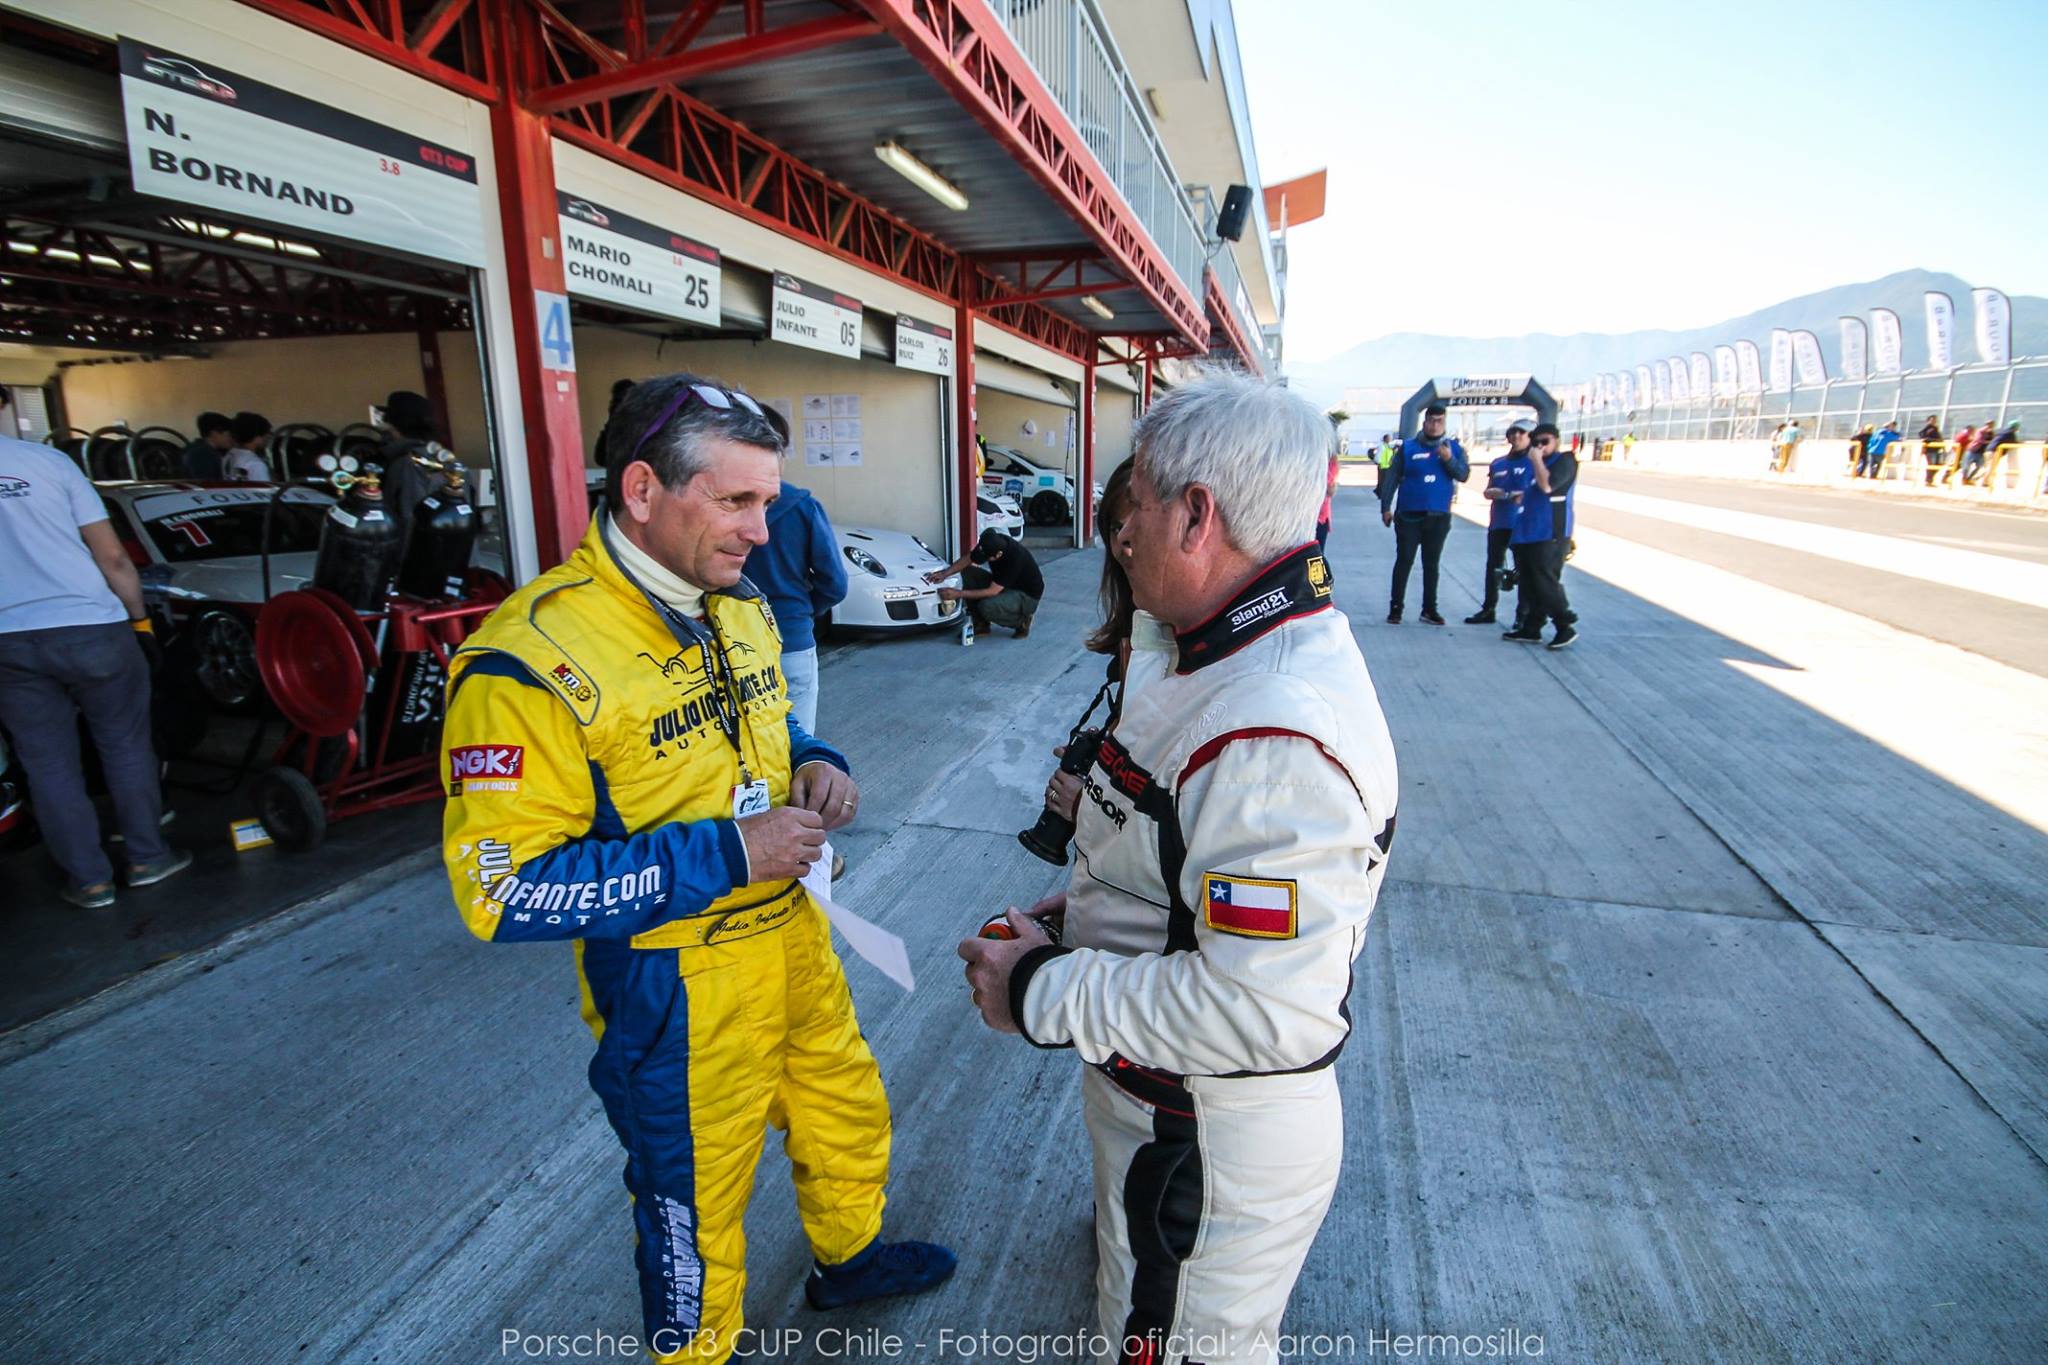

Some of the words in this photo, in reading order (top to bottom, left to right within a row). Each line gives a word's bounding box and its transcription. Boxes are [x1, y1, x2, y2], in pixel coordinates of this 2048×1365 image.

[143, 107, 192, 142] N.
[379, 158, 400, 176] 3.8
[148, 147, 355, 216] BORNAND
[567, 235, 631, 267] MARIO
[568, 261, 653, 295] CHOMALI
[685, 274, 709, 309] 25
[776, 301, 806, 317] JULIO
[543, 303, 571, 364] 4
[776, 319, 818, 339] INFANTE
[840, 321, 856, 347] 05
[938, 347, 949, 367] 26
[1514, 467, 1526, 475] TV
[171, 520, 212, 548] 7
[452, 749, 509, 777] NGK
